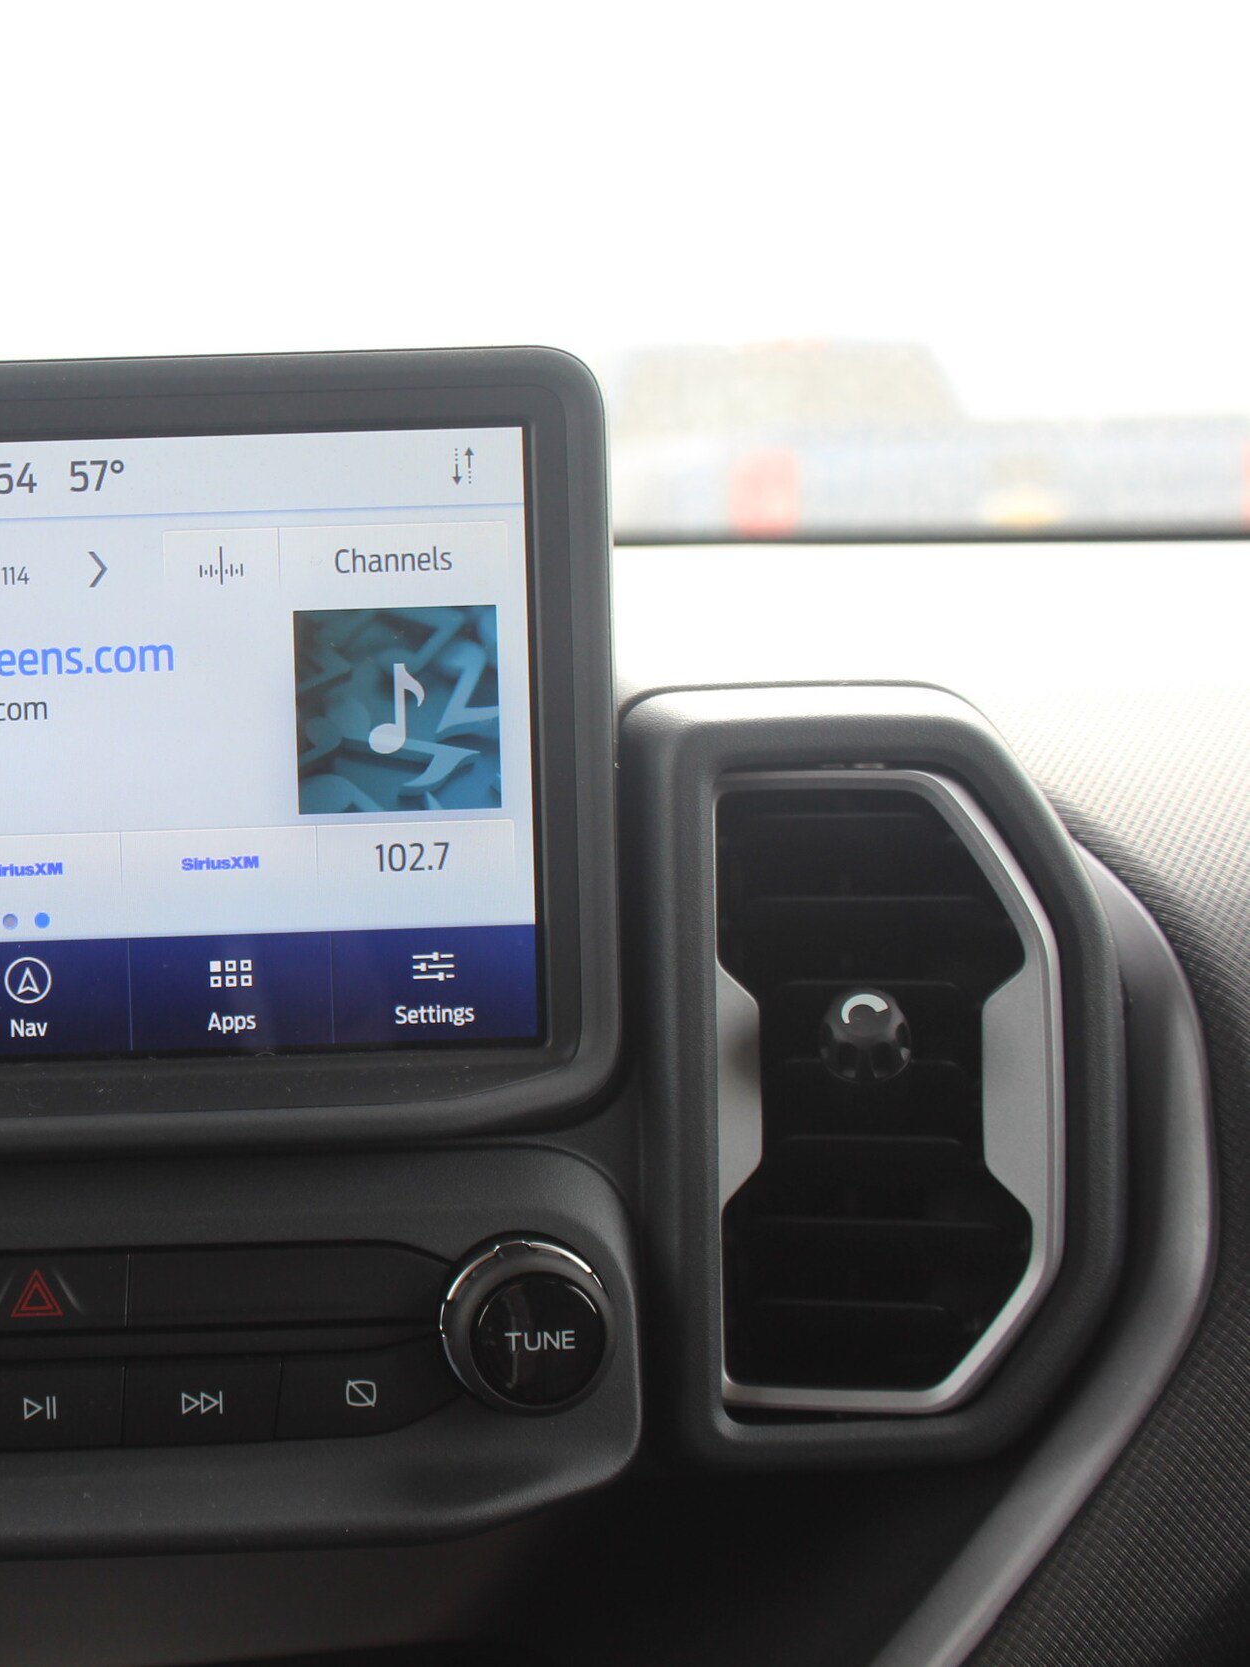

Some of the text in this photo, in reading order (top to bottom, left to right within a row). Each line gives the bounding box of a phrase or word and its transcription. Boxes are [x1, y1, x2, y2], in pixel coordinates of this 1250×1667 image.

[335, 546, 452, 573] Channels
[2, 567, 29, 585] 114
[182, 856, 259, 871] SiriusXM
[376, 842, 449, 872] 102.7
[208, 1012, 256, 1033] Apps
[395, 1005, 474, 1026] Settings
[11, 1019, 47, 1037] Nav
[505, 1330, 575, 1351] TUNE
